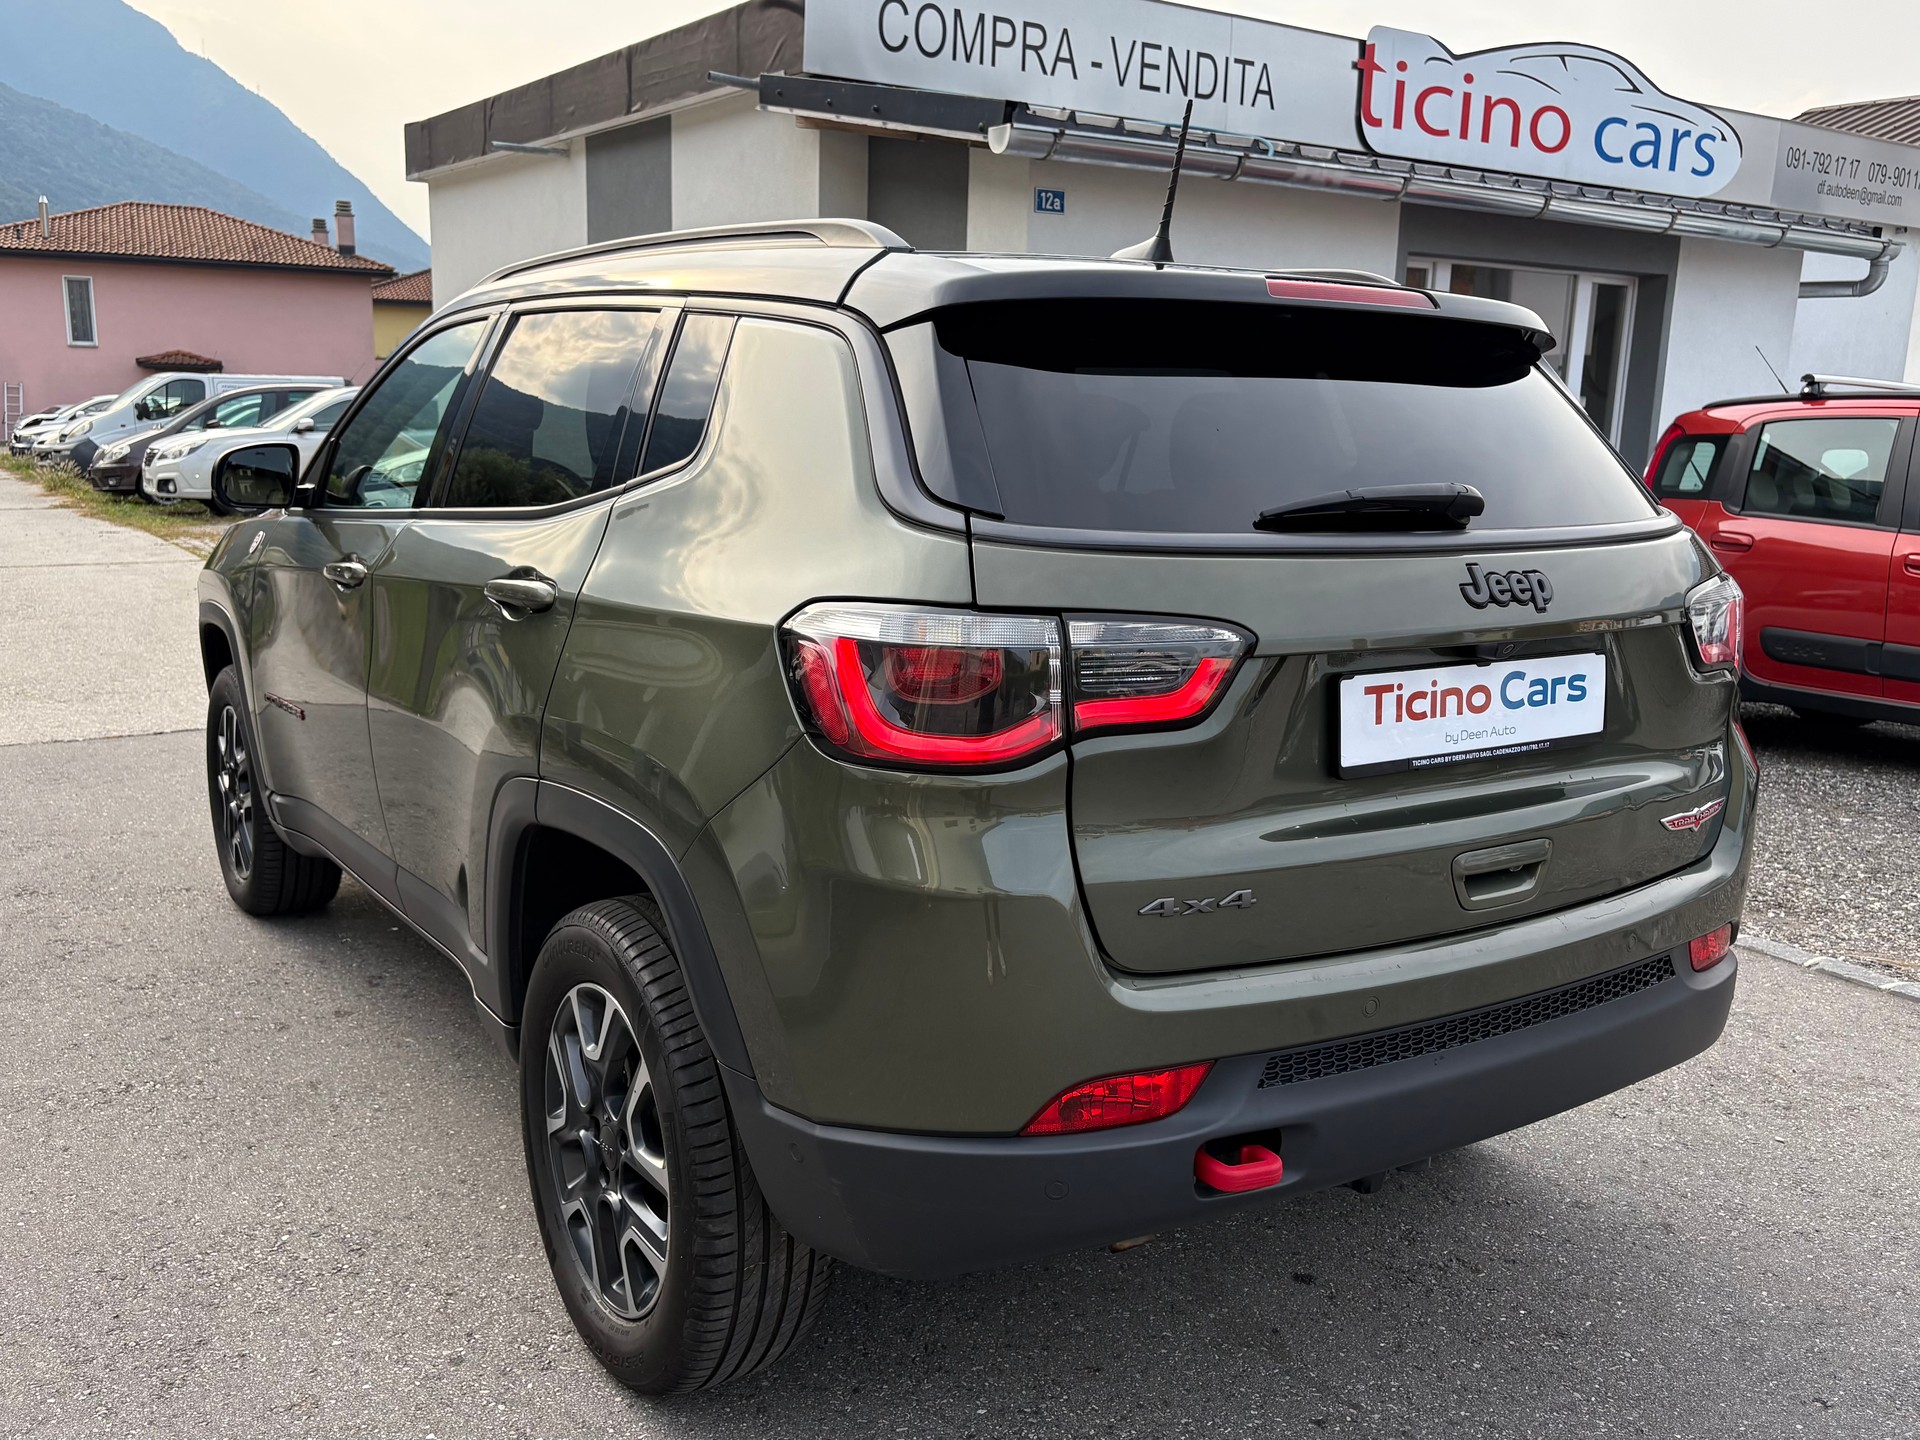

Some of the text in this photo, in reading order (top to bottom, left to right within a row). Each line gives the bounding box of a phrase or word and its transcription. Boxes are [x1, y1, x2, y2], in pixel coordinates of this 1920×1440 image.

[878, 0, 1079, 80] COMPRA
[1110, 36, 1276, 110] VENDITA
[1356, 43, 1717, 177] ticino cars
[1786, 146, 1832, 175] 091-792
[1835, 155, 1847, 177] 17
[1850, 158, 1861, 179] 17
[1040, 192, 1061, 210] 12a
[1817, 180, 1903, 207] df.autodeen@gmail.com
[1458, 562, 1554, 613] Jeep
[1364, 670, 1587, 725] Ticino Cars
[1445, 725, 1517, 744] by Deen Auto
[1412, 759, 1430, 767] TICINO
[1431, 757, 1444, 765] CARS
[1452, 754, 1465, 762] DEEN
[1466, 752, 1479, 760] AUTO
[1493, 746, 1520, 756] CADENAZZO
